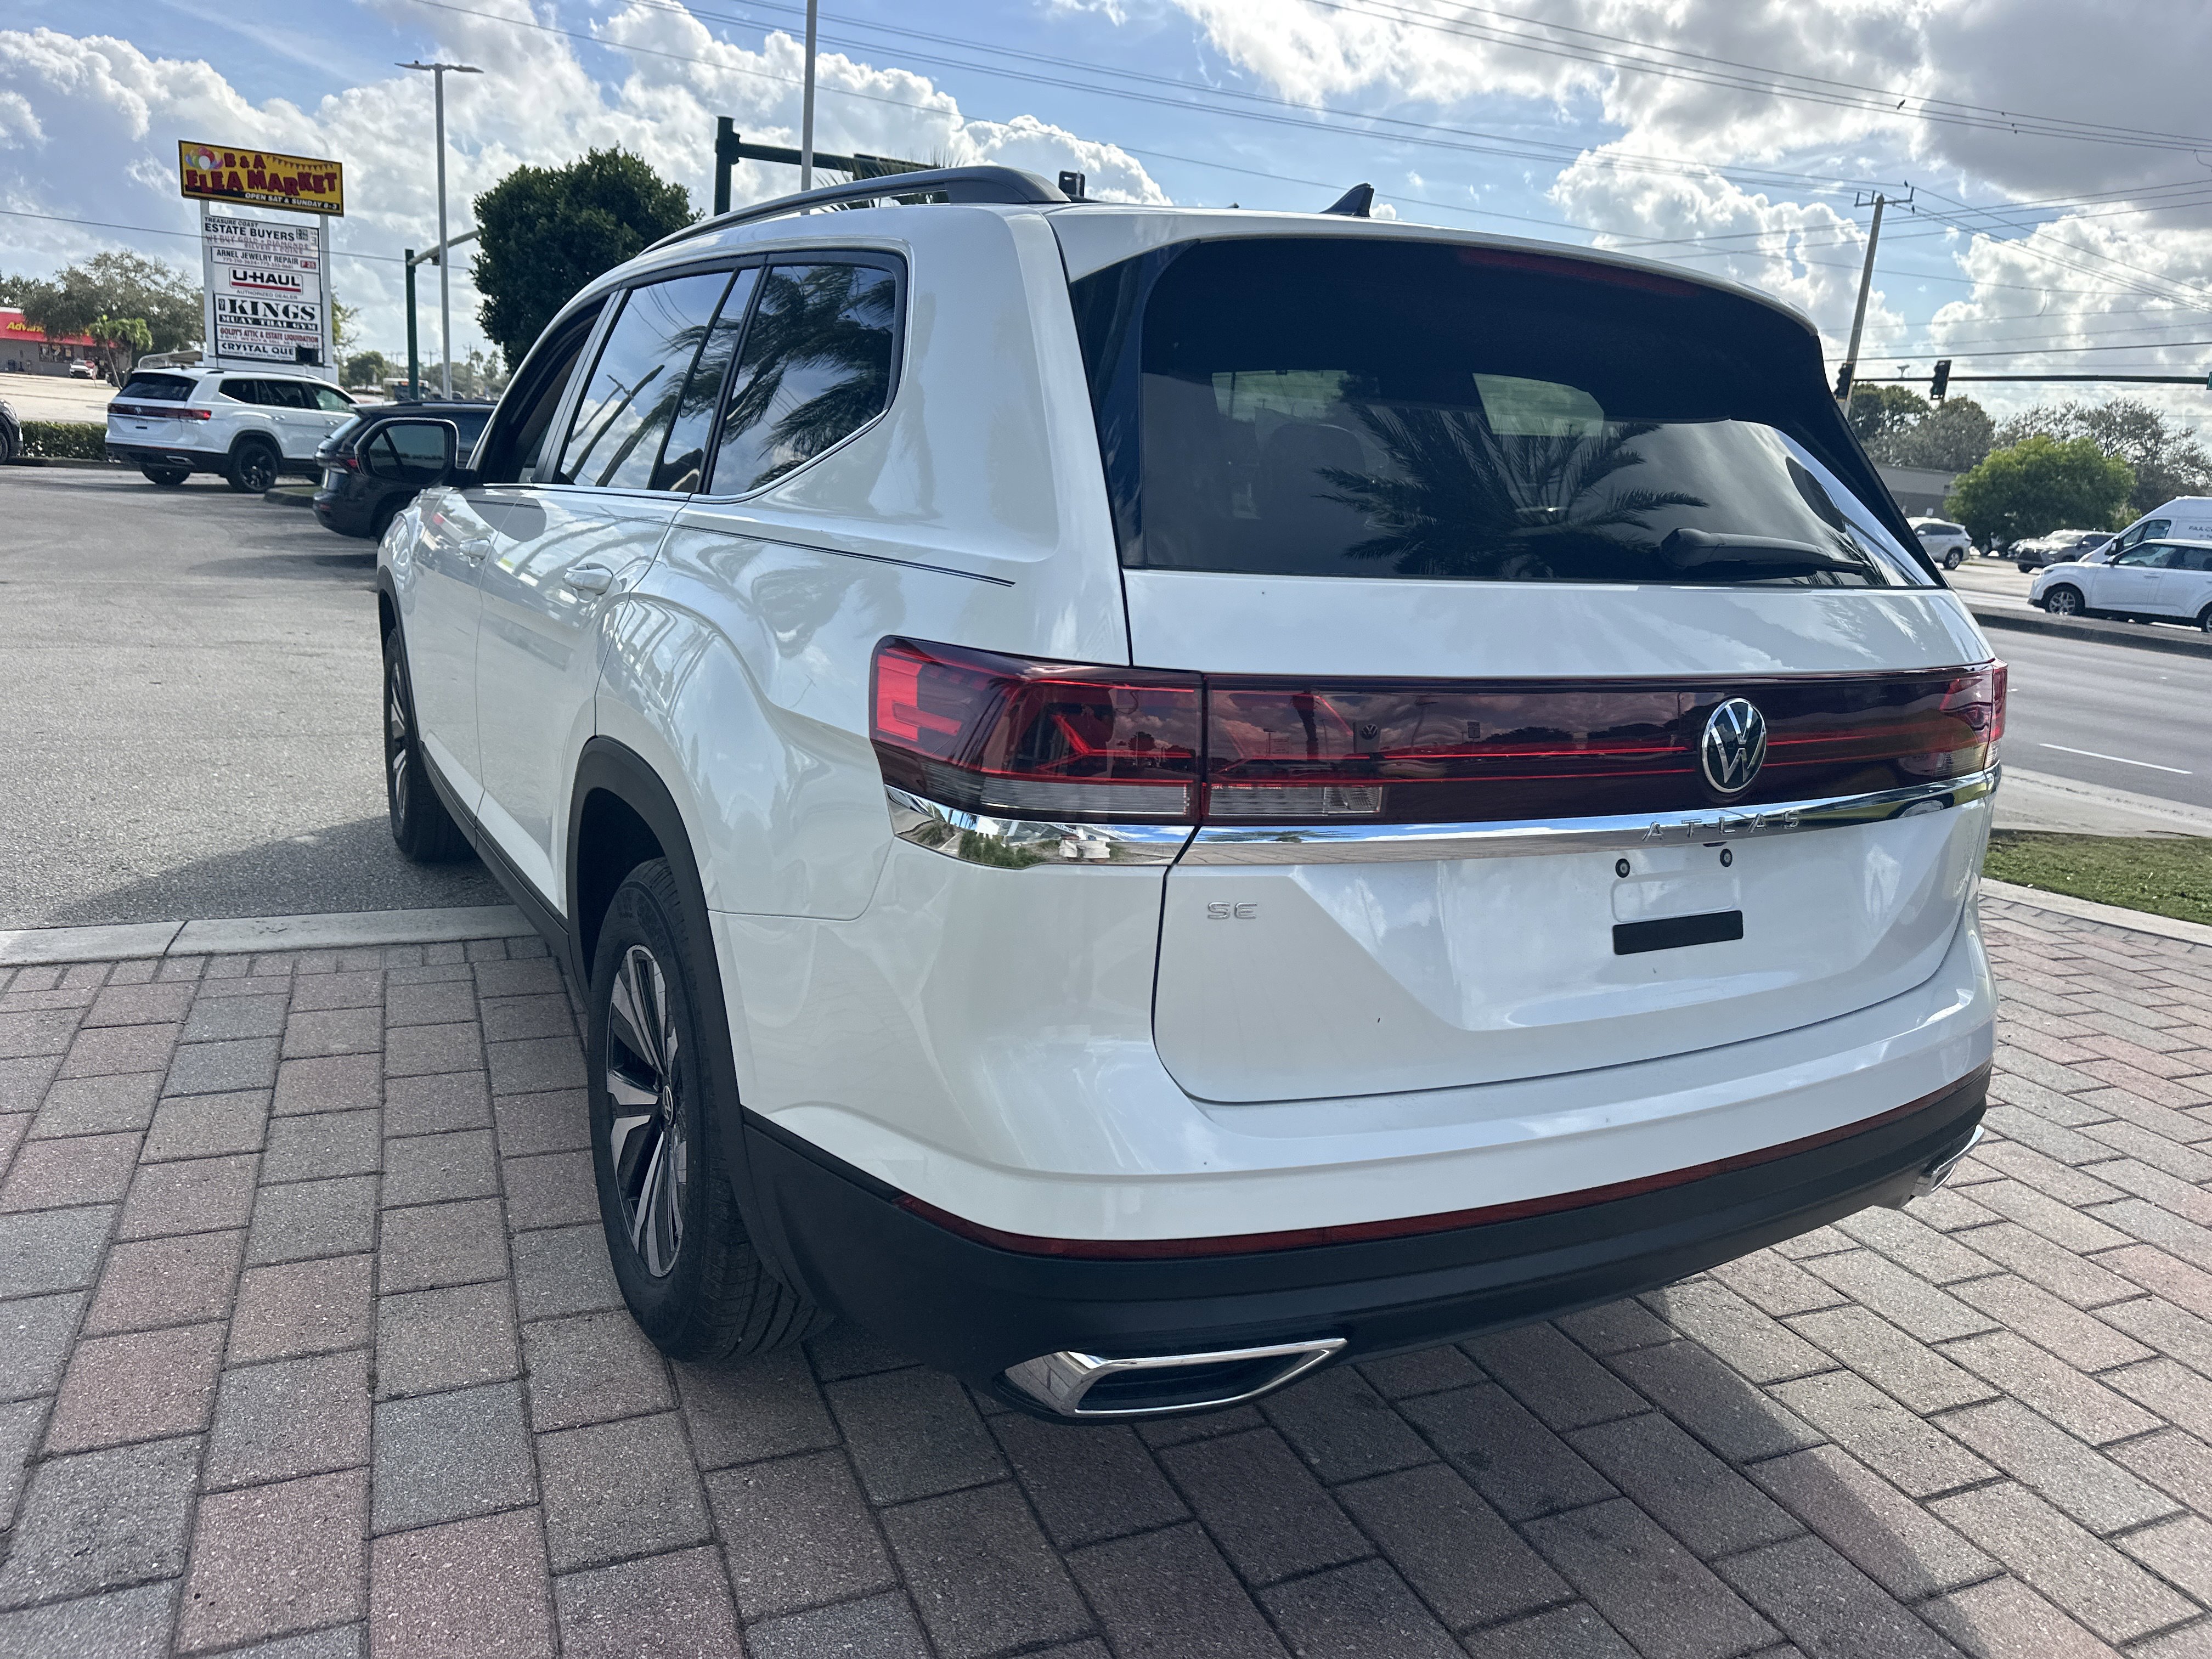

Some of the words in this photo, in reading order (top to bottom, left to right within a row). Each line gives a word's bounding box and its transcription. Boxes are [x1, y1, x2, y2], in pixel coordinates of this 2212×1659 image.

[224, 153, 236, 167] B
[240, 156, 250, 168] &
[253, 155, 266, 169] A
[186, 170, 244, 193] FLEA
[247, 170, 337, 196] MARKET
[245, 193, 266, 201] OPEN
[291, 198, 322, 207] SUNDAY
[205, 217, 236, 225] TREASURE
[205, 223, 246, 235] ESTATE
[250, 228, 295, 241] BUYERS
[216, 249, 239, 258] ARNEL
[240, 251, 272, 262] JEWELRY
[274, 255, 298, 265] REPAIR
[233, 269, 300, 286] U-HAUL
[236, 289, 273, 298] AUTHORIZED
[228, 298, 315, 321] KINGS
[221, 315, 253, 325] MUAY
[259, 319, 287, 328] THAI
[244, 330, 258, 338] ATTIC
[265, 332, 283, 340] ESTATE
[284, 334, 318, 343] LIQUIDATION
[222, 342, 268, 353] CRYSTAL
[1641, 810, 1800, 842] ATLAS
[1207, 901, 1257, 919] SE
